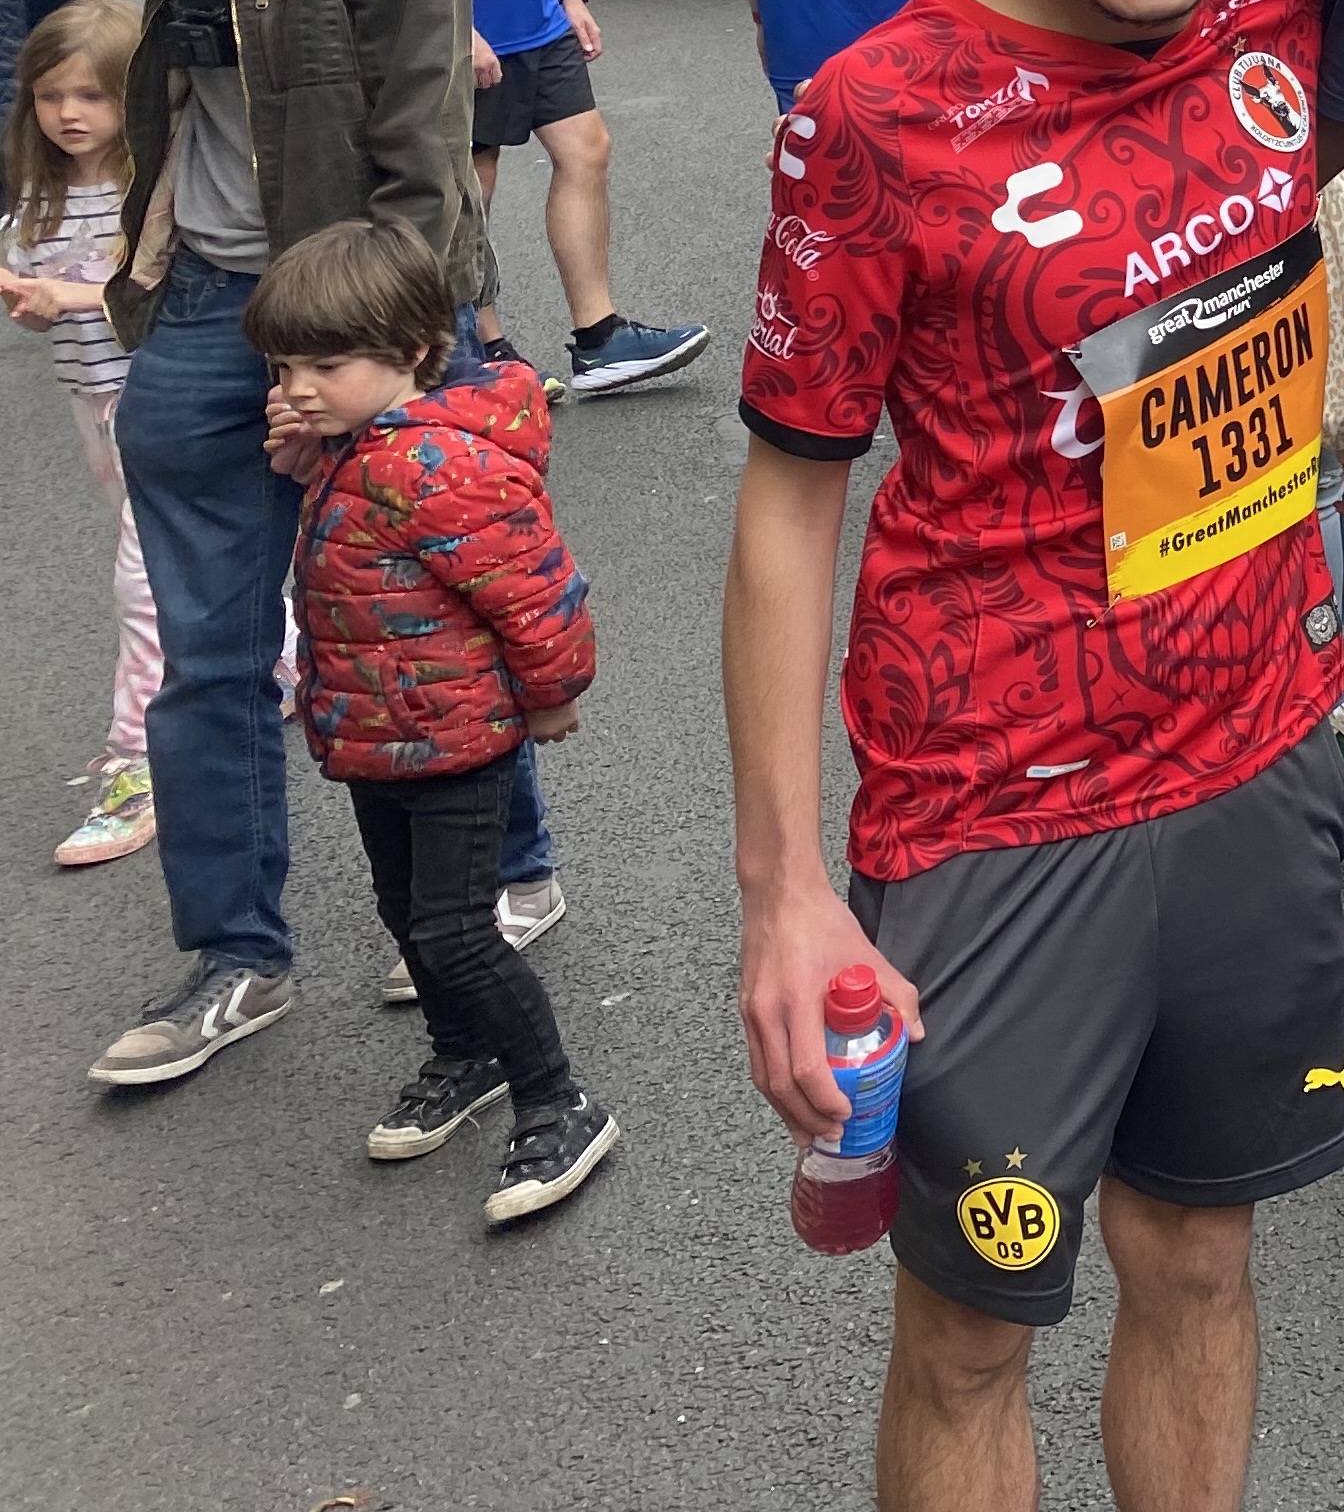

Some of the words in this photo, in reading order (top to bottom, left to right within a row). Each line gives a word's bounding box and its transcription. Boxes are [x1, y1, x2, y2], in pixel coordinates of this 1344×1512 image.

[1232, 67, 1244, 100] CLUB
[1238, 54, 1283, 72] TIJUANA
[1123, 194, 1255, 298] ARCO
[1148, 313, 1192, 345] great
[1204, 258, 1285, 318] manchester
[1226, 297, 1251, 323] run
[1141, 302, 1314, 450] CAMERON
[1191, 392, 1294, 499] 1331
[968, 1188, 1046, 1240] BVB
[996, 1241, 1024, 1259] 09
